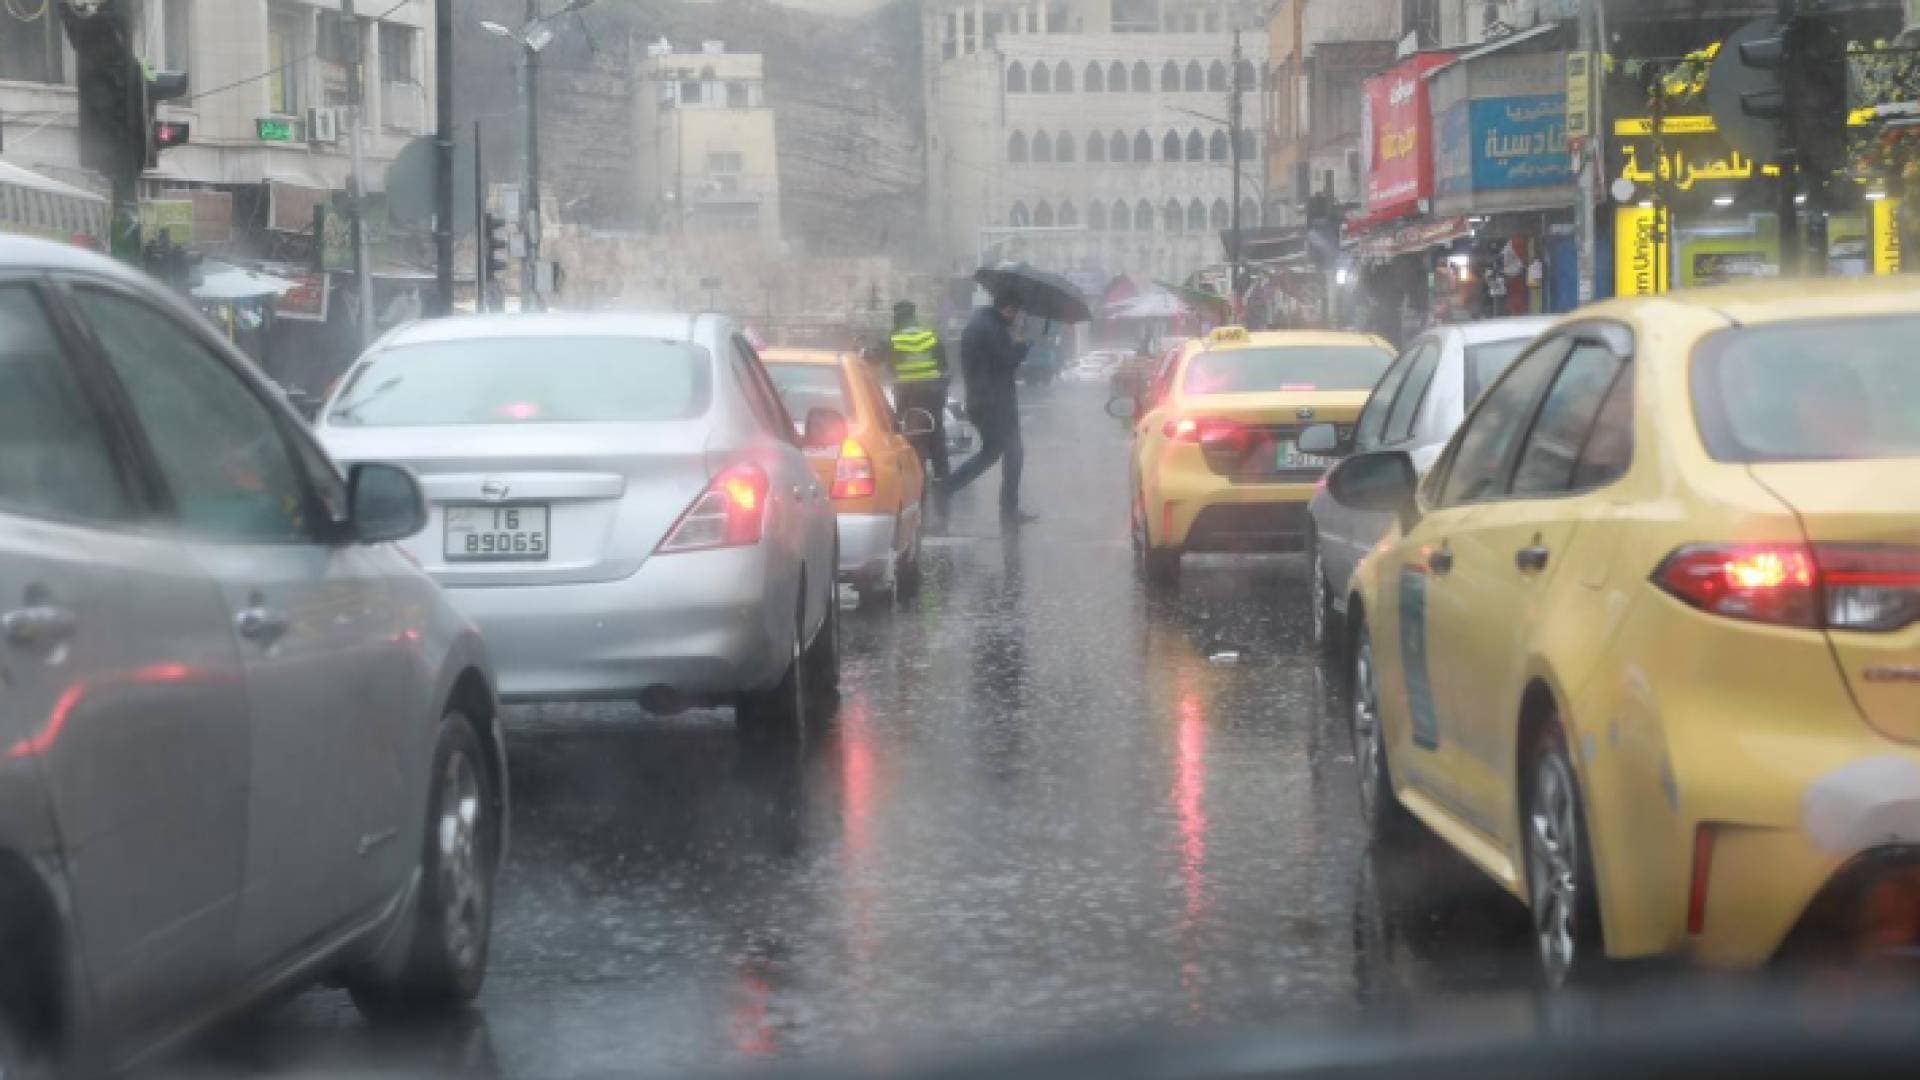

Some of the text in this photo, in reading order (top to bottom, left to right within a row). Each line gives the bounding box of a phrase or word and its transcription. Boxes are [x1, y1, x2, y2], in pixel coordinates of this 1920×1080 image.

[1633, 216, 1649, 271] Union
[493, 509, 519, 530] 16
[465, 532, 544, 552] 89065
